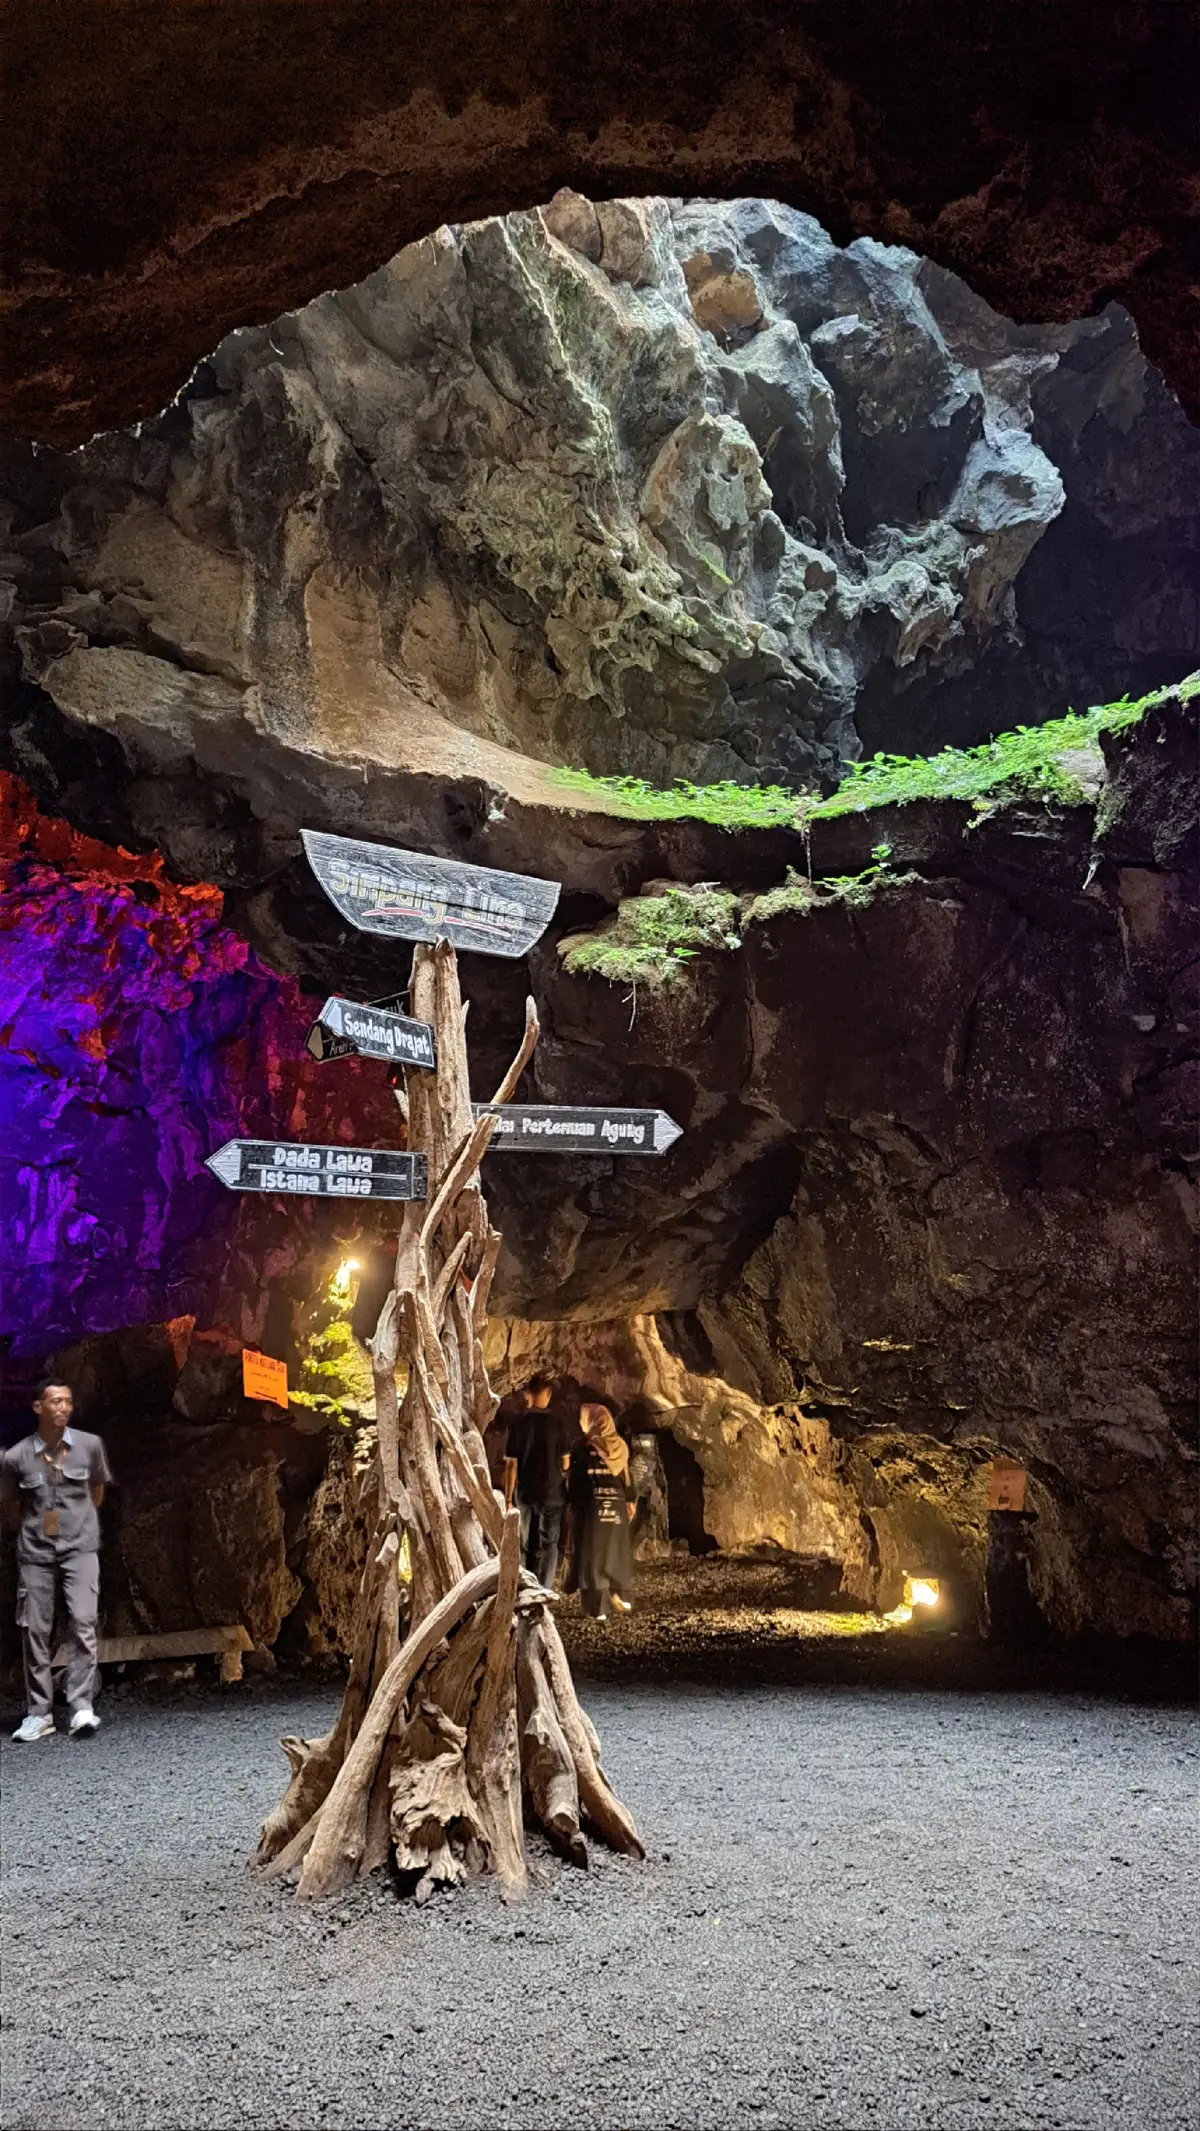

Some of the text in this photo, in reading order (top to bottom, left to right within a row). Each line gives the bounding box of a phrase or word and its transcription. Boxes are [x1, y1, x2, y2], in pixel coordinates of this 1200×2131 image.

[327, 860, 446, 926] Simpang
[343, 1012, 430, 1059] Sendang Drajat
[522, 1117, 596, 1136] Pertemuan
[601, 1119, 645, 1144] Agung
[273, 1147, 373, 1173] Dada Lawa
[260, 1169, 373, 1195] Istana Lawa
